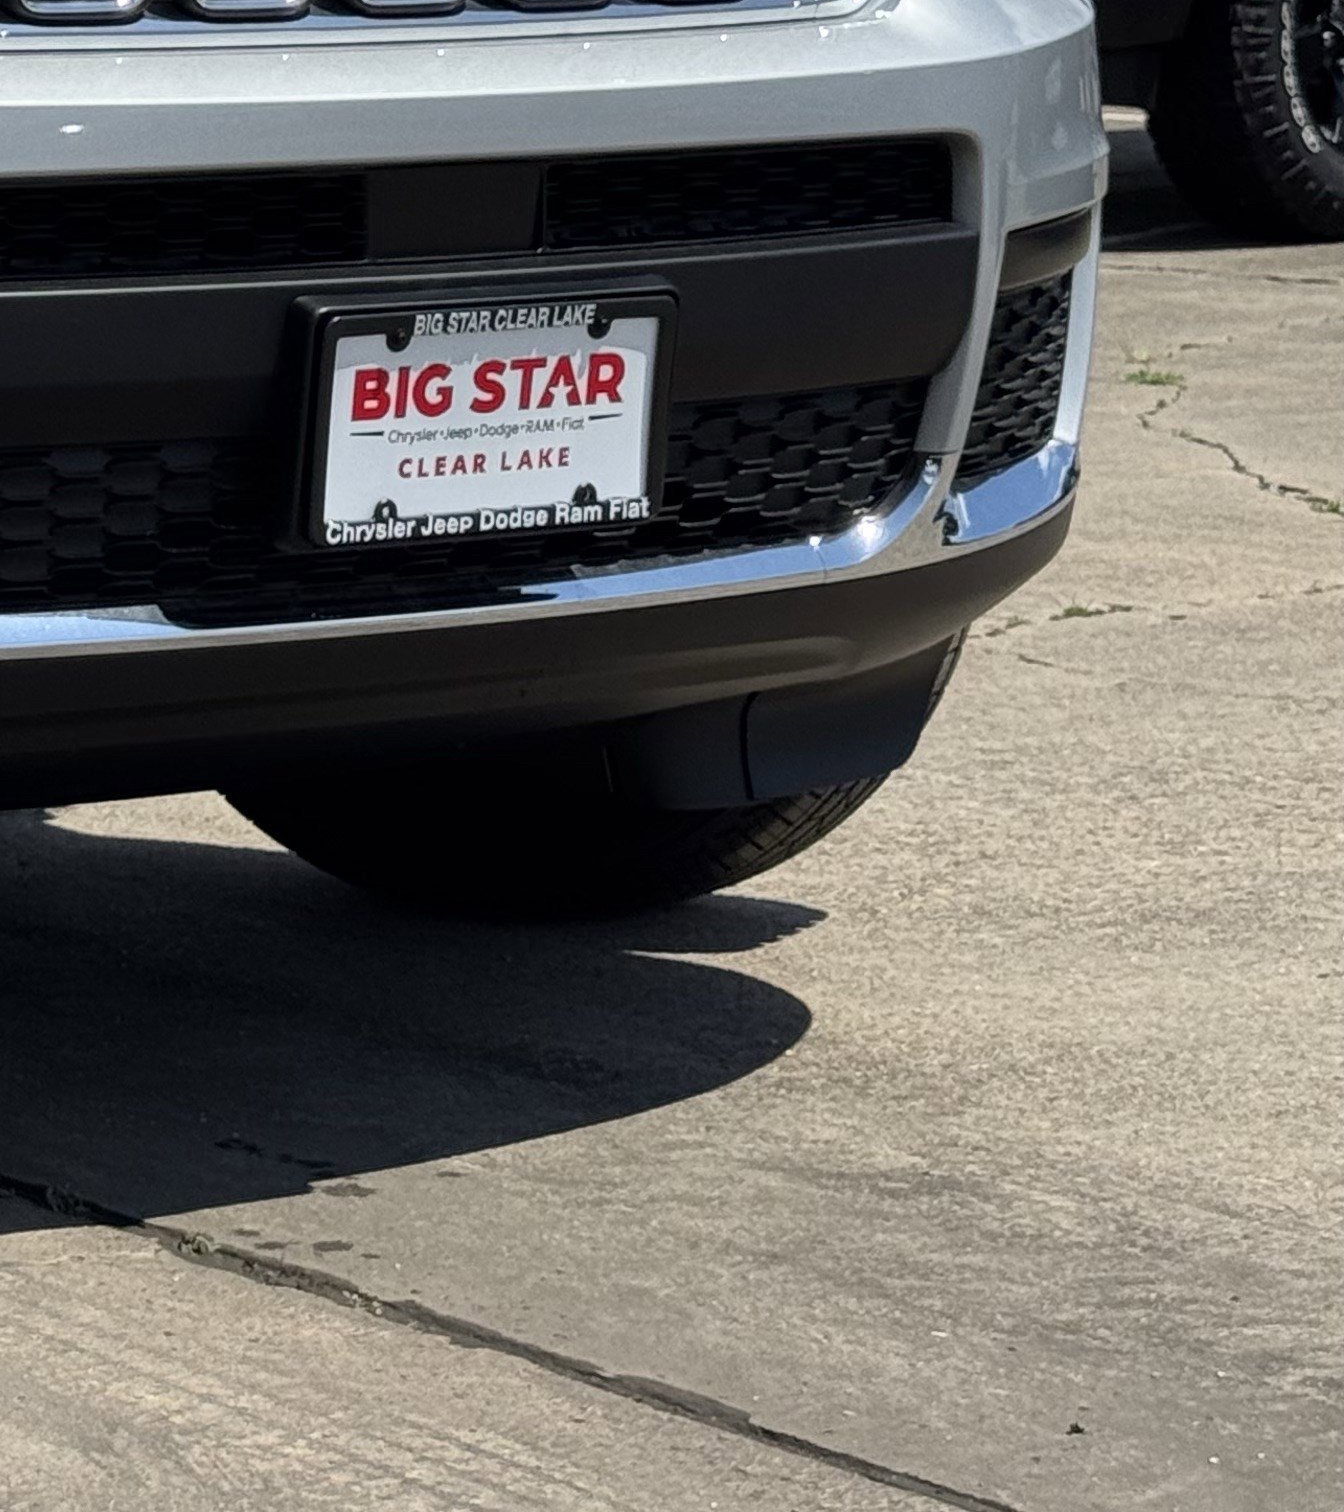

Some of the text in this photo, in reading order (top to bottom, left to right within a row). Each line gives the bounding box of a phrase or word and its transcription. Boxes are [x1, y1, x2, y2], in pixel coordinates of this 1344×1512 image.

[414, 303, 597, 336] BIG STAR CLEAR LAKE
[350, 352, 626, 422] BIG STAR
[398, 446, 571, 479] CLEAR LAKE
[326, 497, 650, 546] Chrysler Jeep Dodge Ram Fiat
